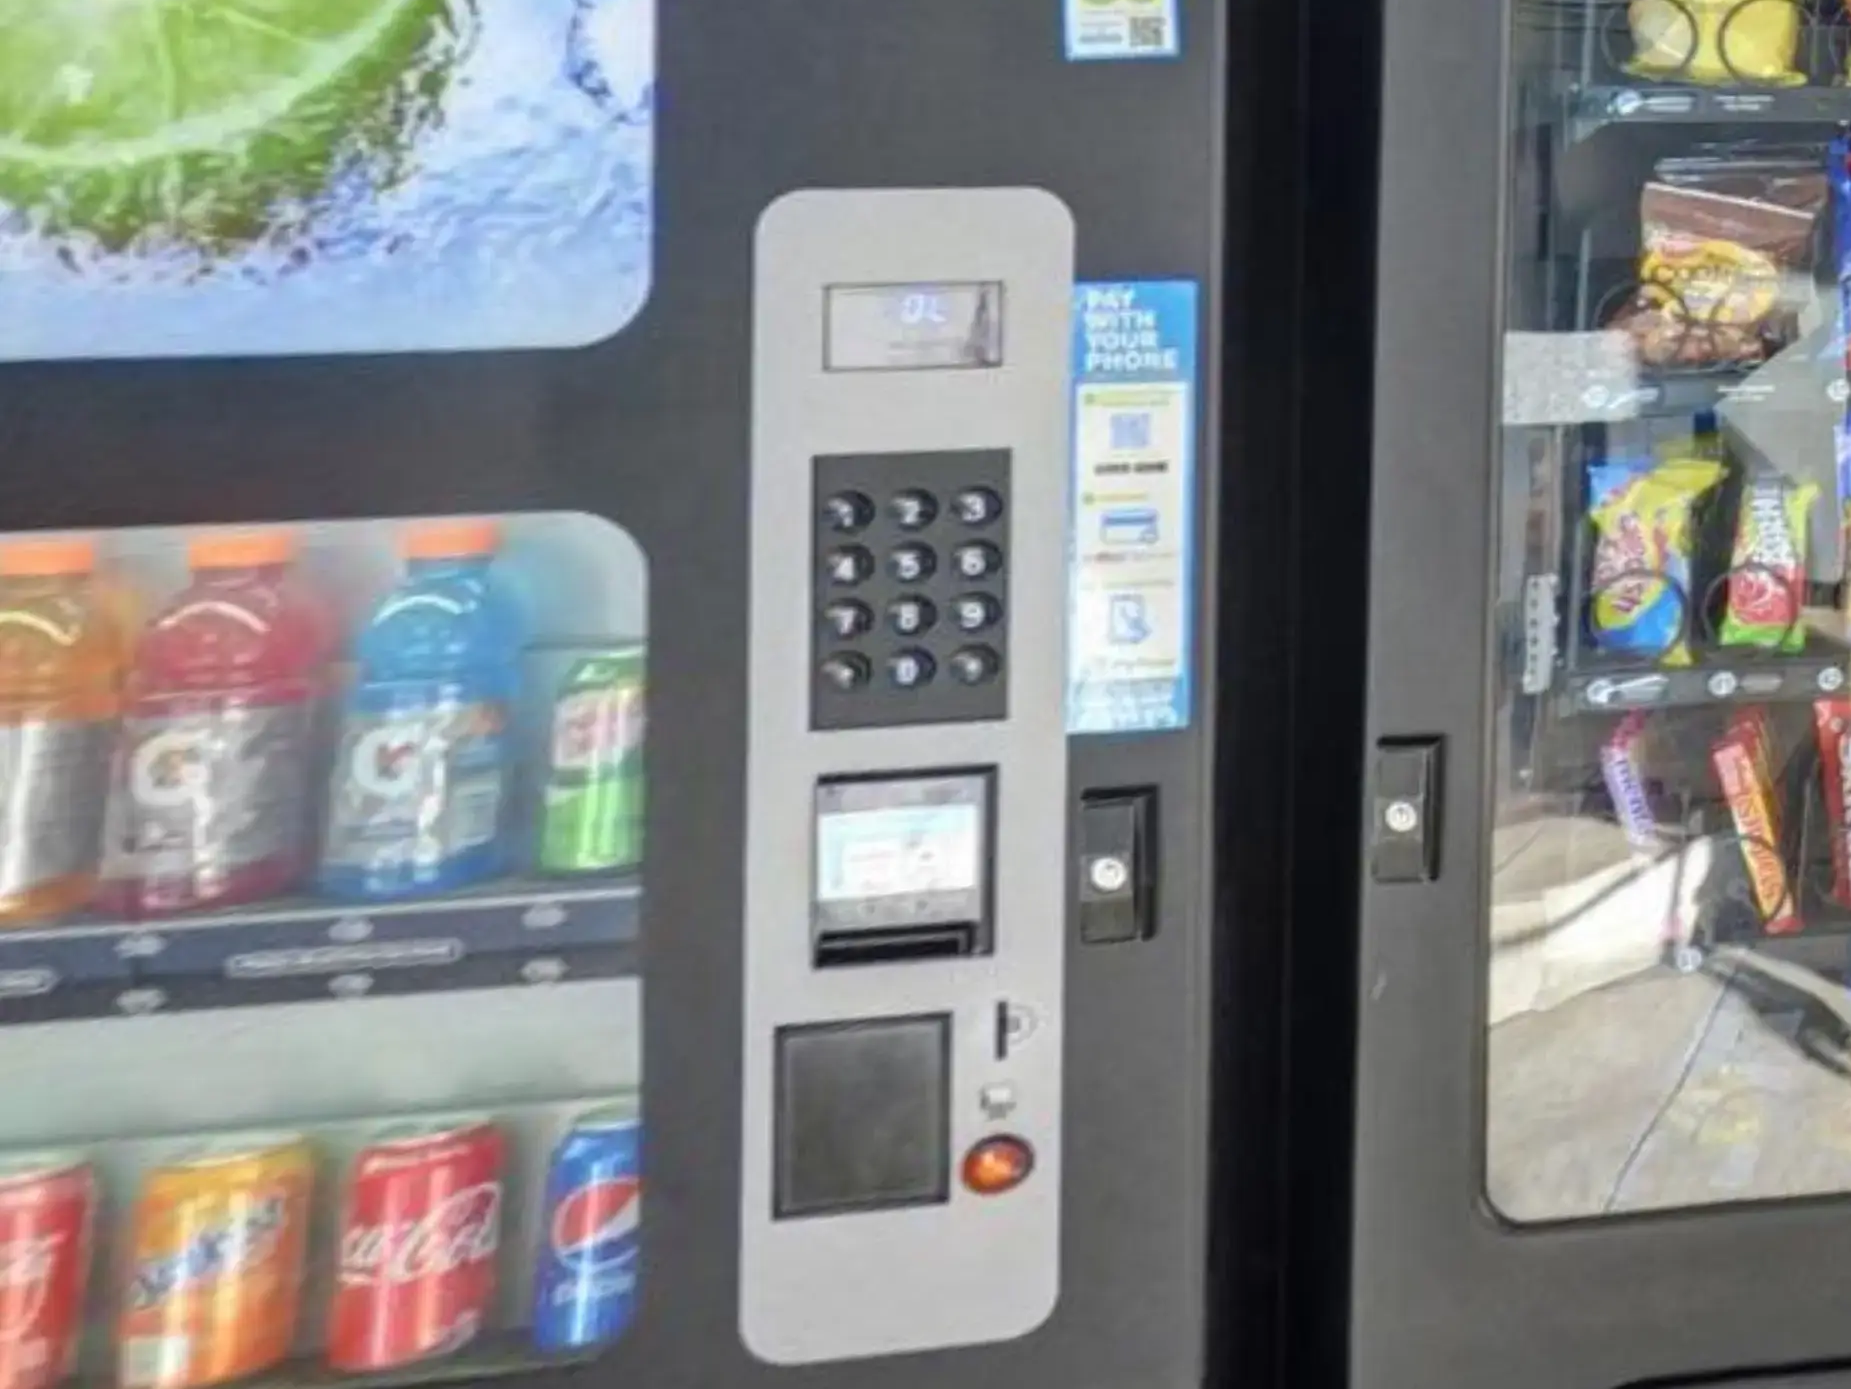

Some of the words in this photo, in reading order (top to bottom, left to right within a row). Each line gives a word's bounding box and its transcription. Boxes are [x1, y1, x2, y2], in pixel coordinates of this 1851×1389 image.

[1086, 289, 1136, 310] PAY
[1085, 311, 1156, 330] WITH
[1086, 331, 1158, 350] YOUR
[1086, 350, 1179, 372] PHONE
